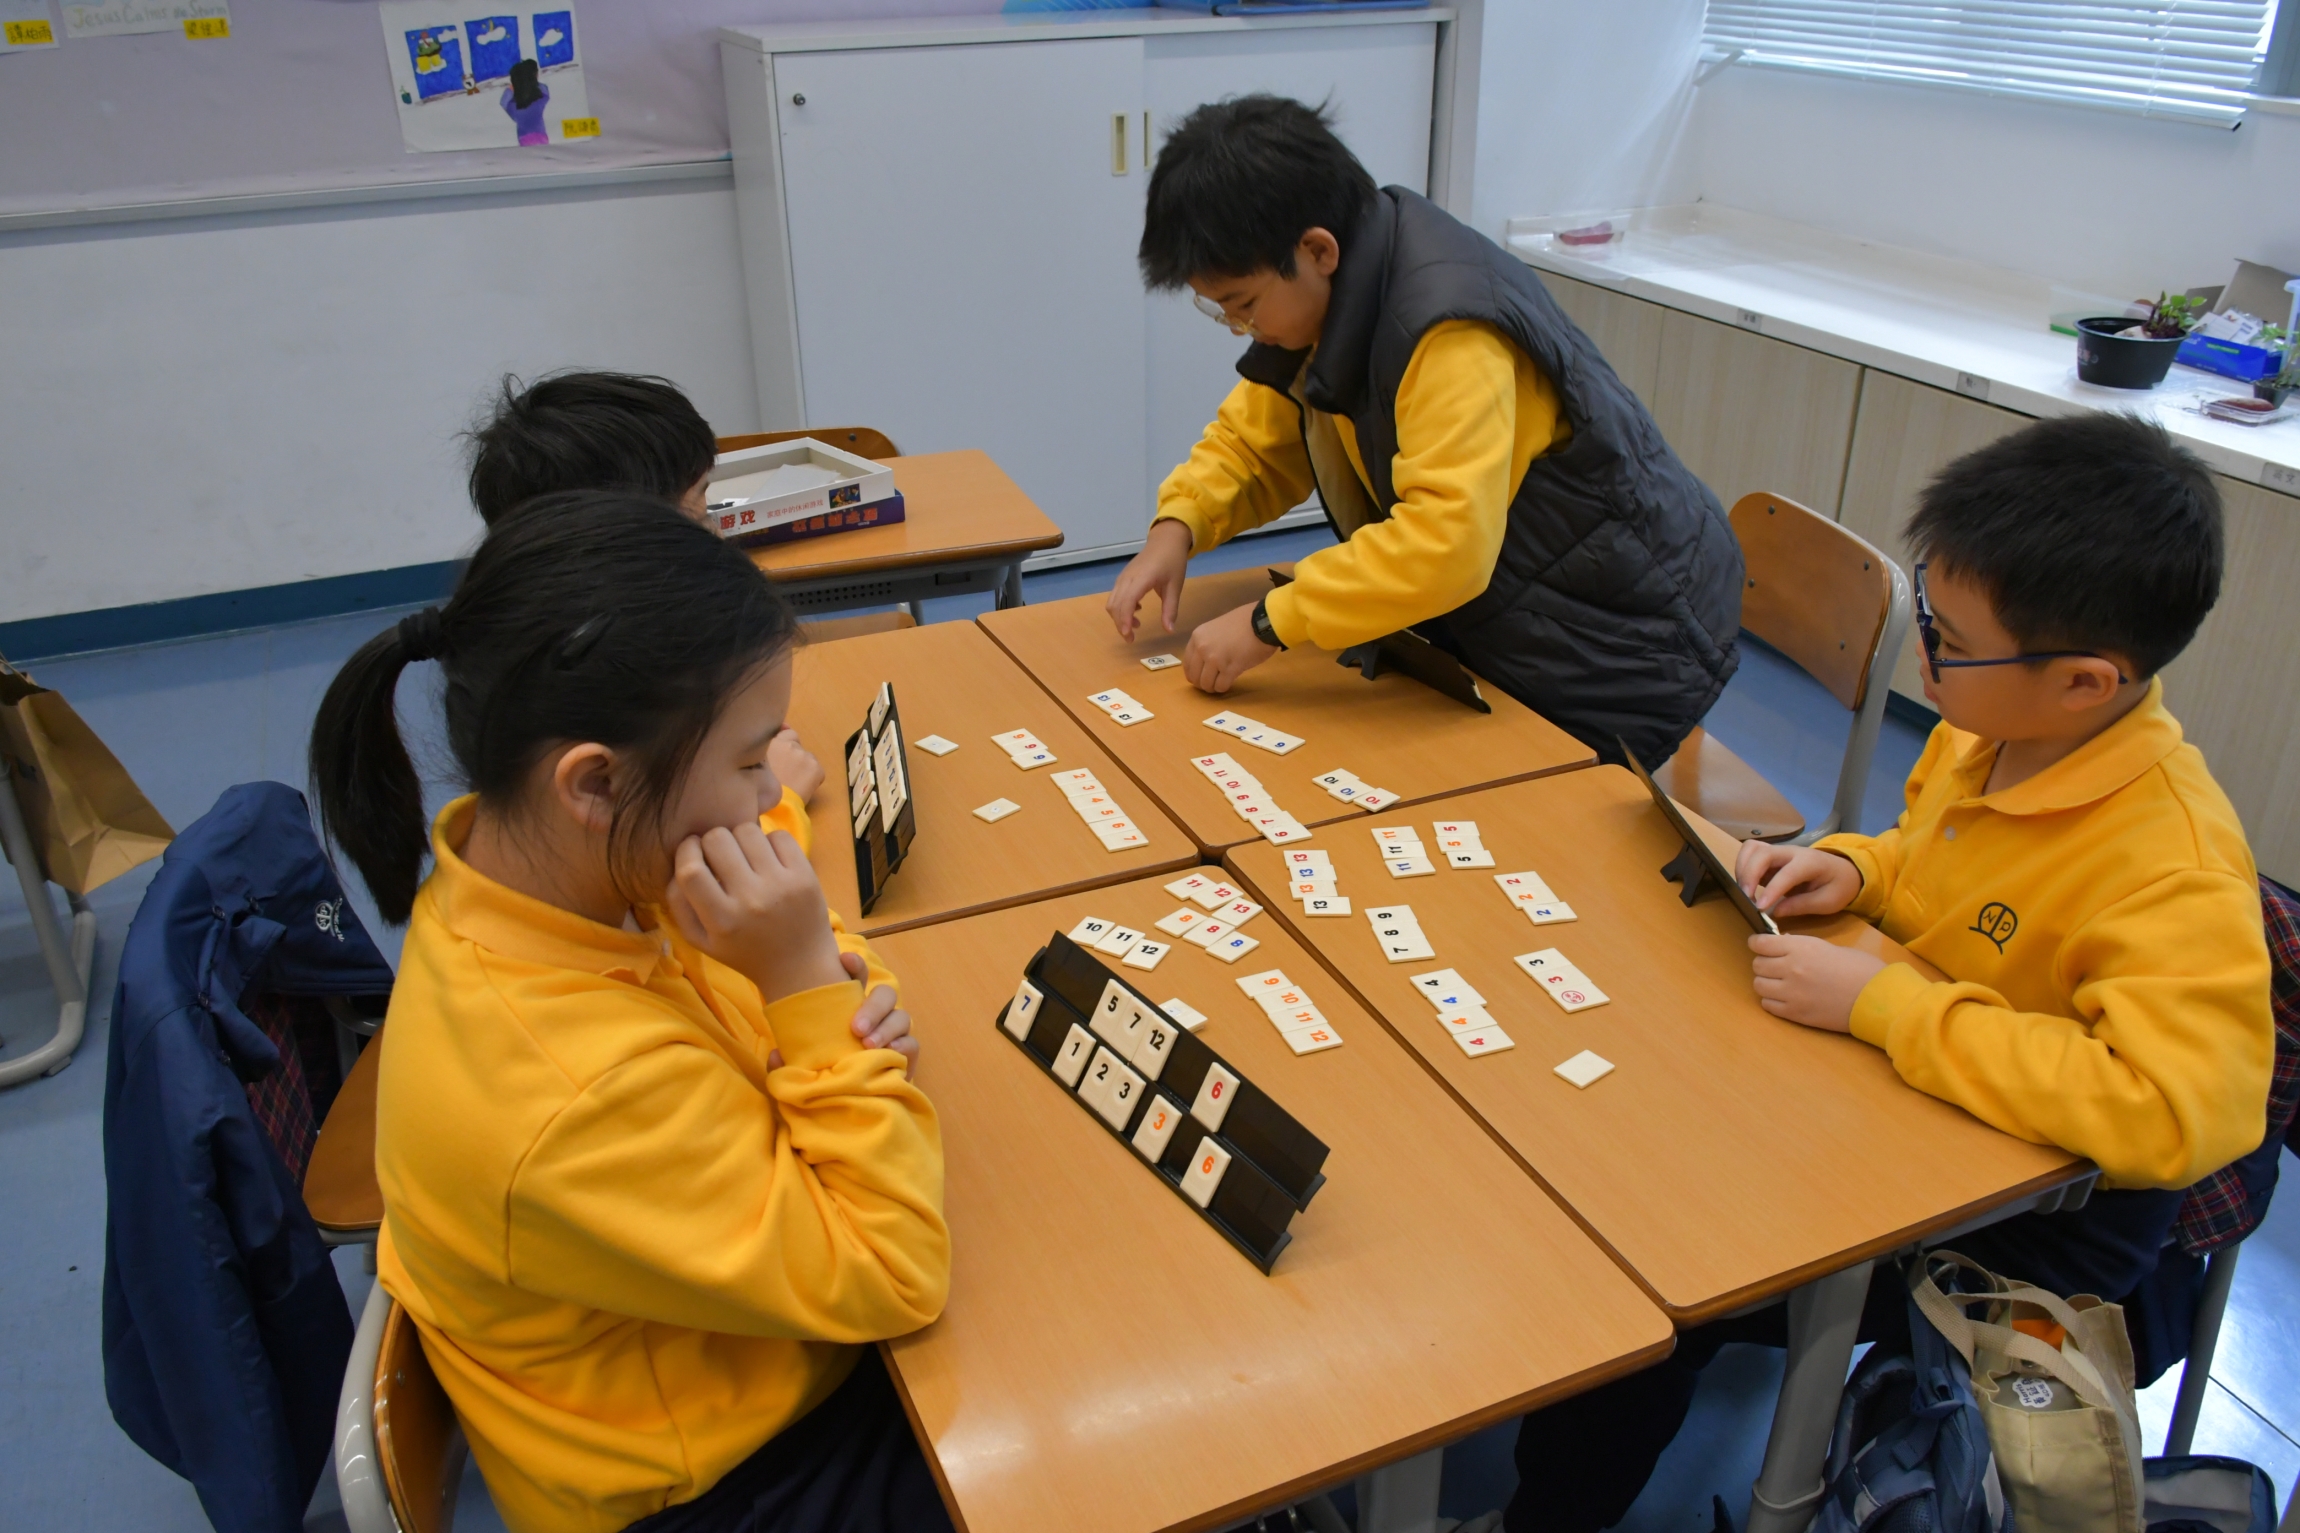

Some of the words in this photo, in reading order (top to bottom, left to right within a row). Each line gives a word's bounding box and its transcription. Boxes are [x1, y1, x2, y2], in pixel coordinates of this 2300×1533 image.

[73, 7, 121, 28] Jesus
[720, 509, 756, 530] 游戏
[1119, 713, 1132, 721] 13
[1200, 758, 1215, 766] 12
[1214, 769, 1228, 778] 11
[1324, 776, 1339, 784] 10
[1226, 781, 1241, 789] 10
[1365, 796, 1380, 804] 10
[1382, 831, 1397, 839] 11
[1389, 846, 1402, 854] 11
[1293, 853, 1308, 862] 13
[1396, 862, 1412, 871] 11
[1299, 868, 1314, 877] 13
[1299, 884, 1314, 893] 13
[1186, 879, 1203, 888] 11
[1214, 887, 1231, 897] 12
[1232, 903, 1250, 913] 13
[1313, 900, 1328, 909] 13
[1536, 908, 1551, 916] 2
[1085, 922, 1102, 931] 10
[1116, 931, 1133, 942] 11
[1140, 945, 1159, 955] 12
[1207, 925, 1220, 933] 8
[1230, 939, 1244, 947] 8
[1424, 979, 1440, 987] 4
[1442, 996, 1457, 1004] 4
[1264, 977, 1279, 985] 9
[1281, 991, 1299, 1004] 10
[1295, 1012, 1314, 1022] 11
[1310, 1030, 1329, 1042] 12
[1107, 996, 1119, 1012] 5
[1129, 1012, 1141, 1029] 7
[1149, 1029, 1165, 1051] 12
[1211, 1081, 1224, 1099] 6
[1020, 995, 1031, 1011] 7
[1071, 1042, 1081, 1056] 1
[1096, 1063, 1109, 1080] 2
[1119, 1082, 1131, 1099] 3
[1153, 1112, 1166, 1130] 3
[1202, 1155, 1215, 1174] 6
[2015, 1383, 2032, 1404] Harris
